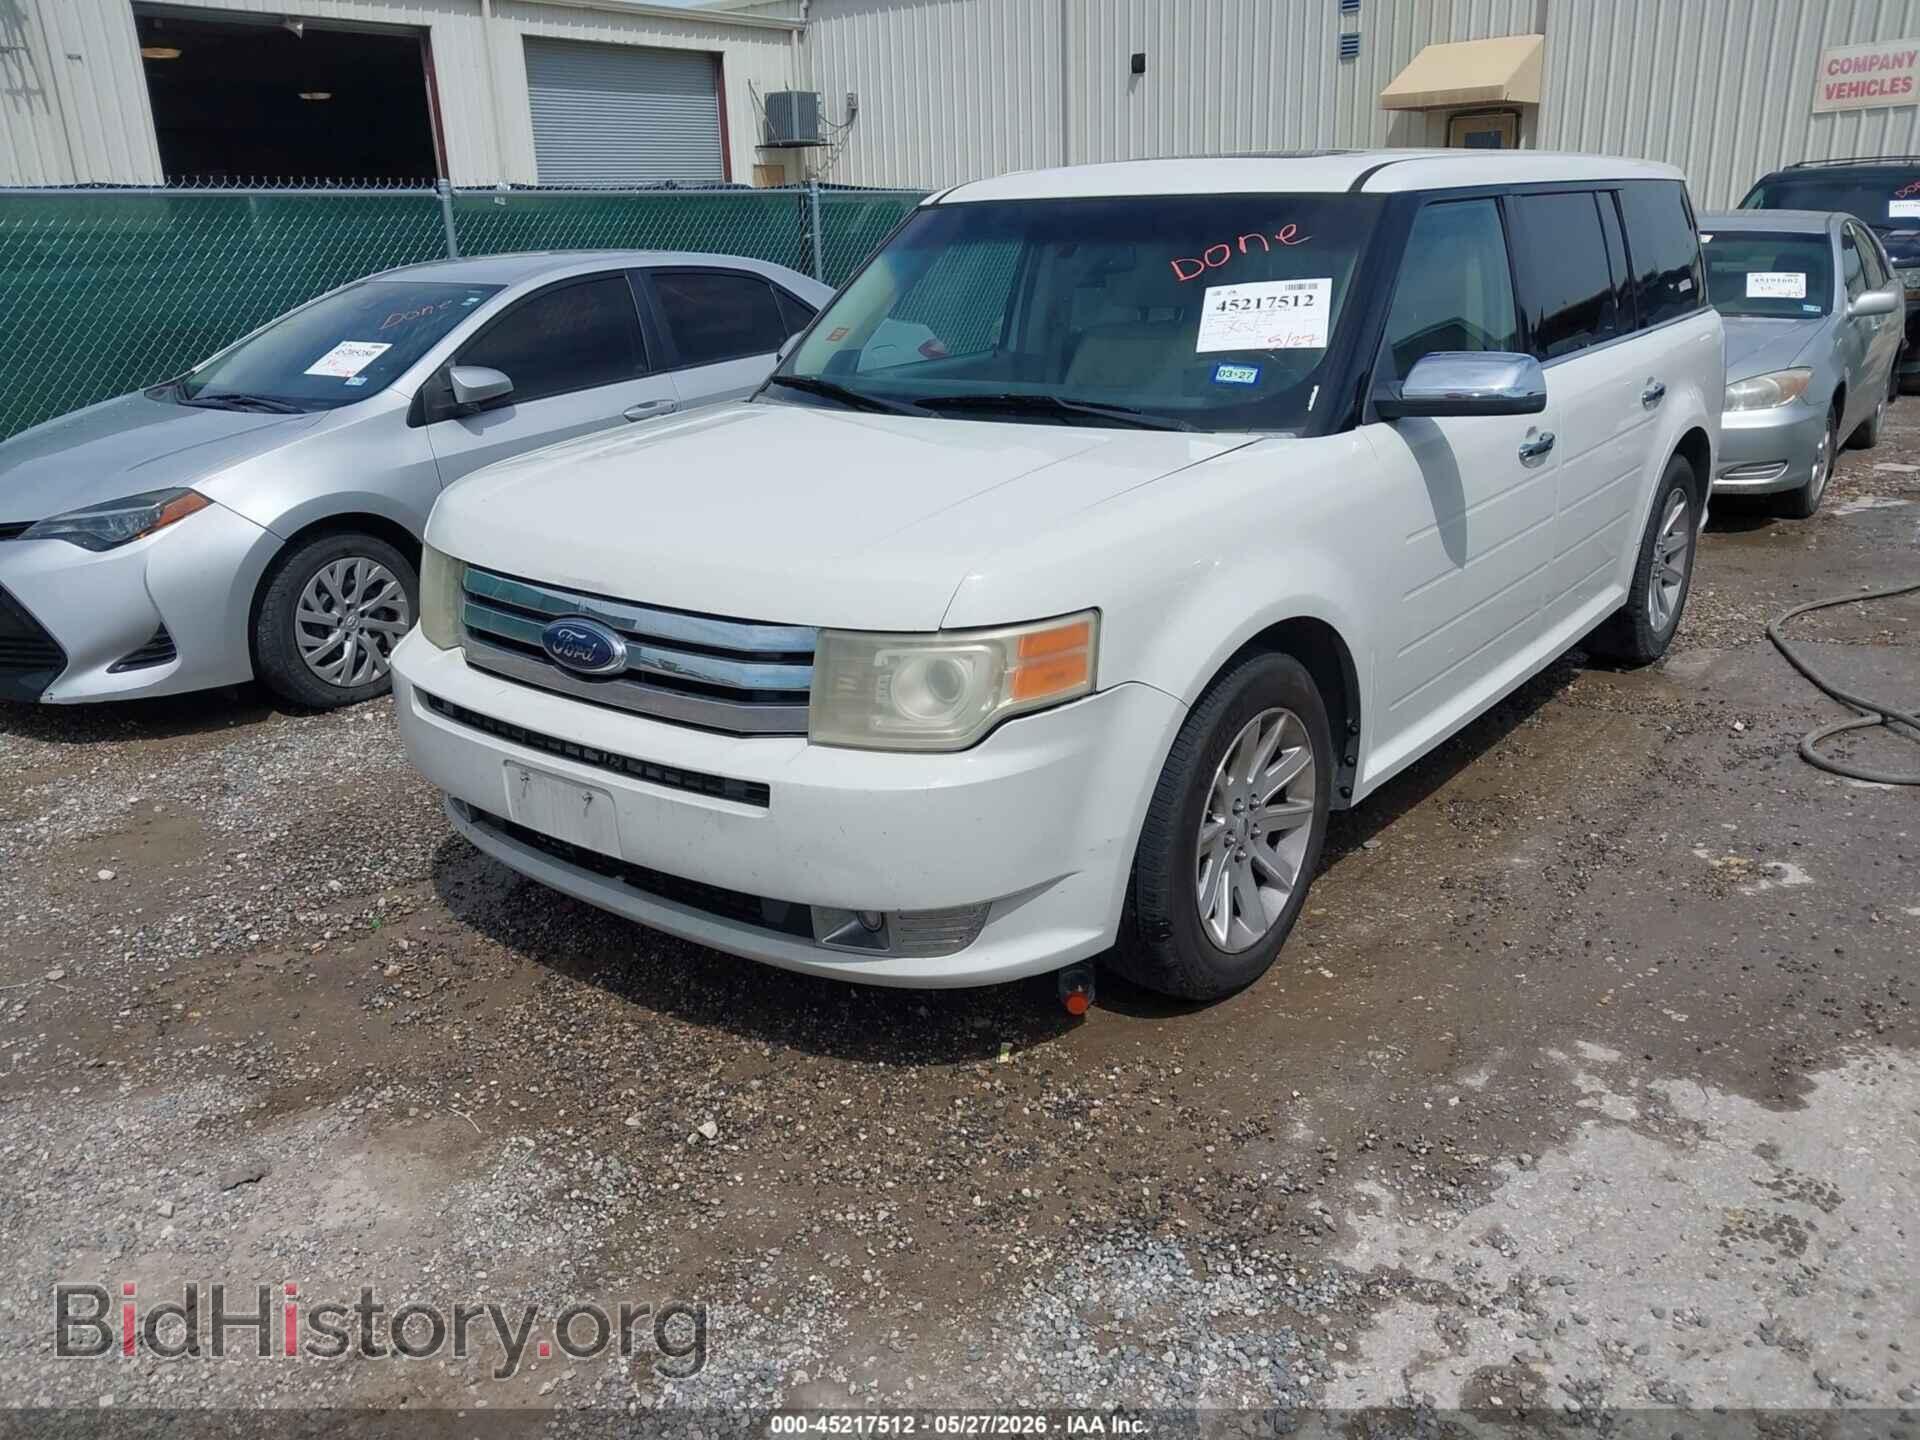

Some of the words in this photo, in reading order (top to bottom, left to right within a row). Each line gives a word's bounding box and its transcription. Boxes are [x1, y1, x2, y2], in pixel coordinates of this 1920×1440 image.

[1827, 50, 1917, 76] COMPANY
[1825, 76, 1912, 100] VEHICLES
[1216, 293, 1314, 312] 45217512
[553, 629, 598, 662] Ford
